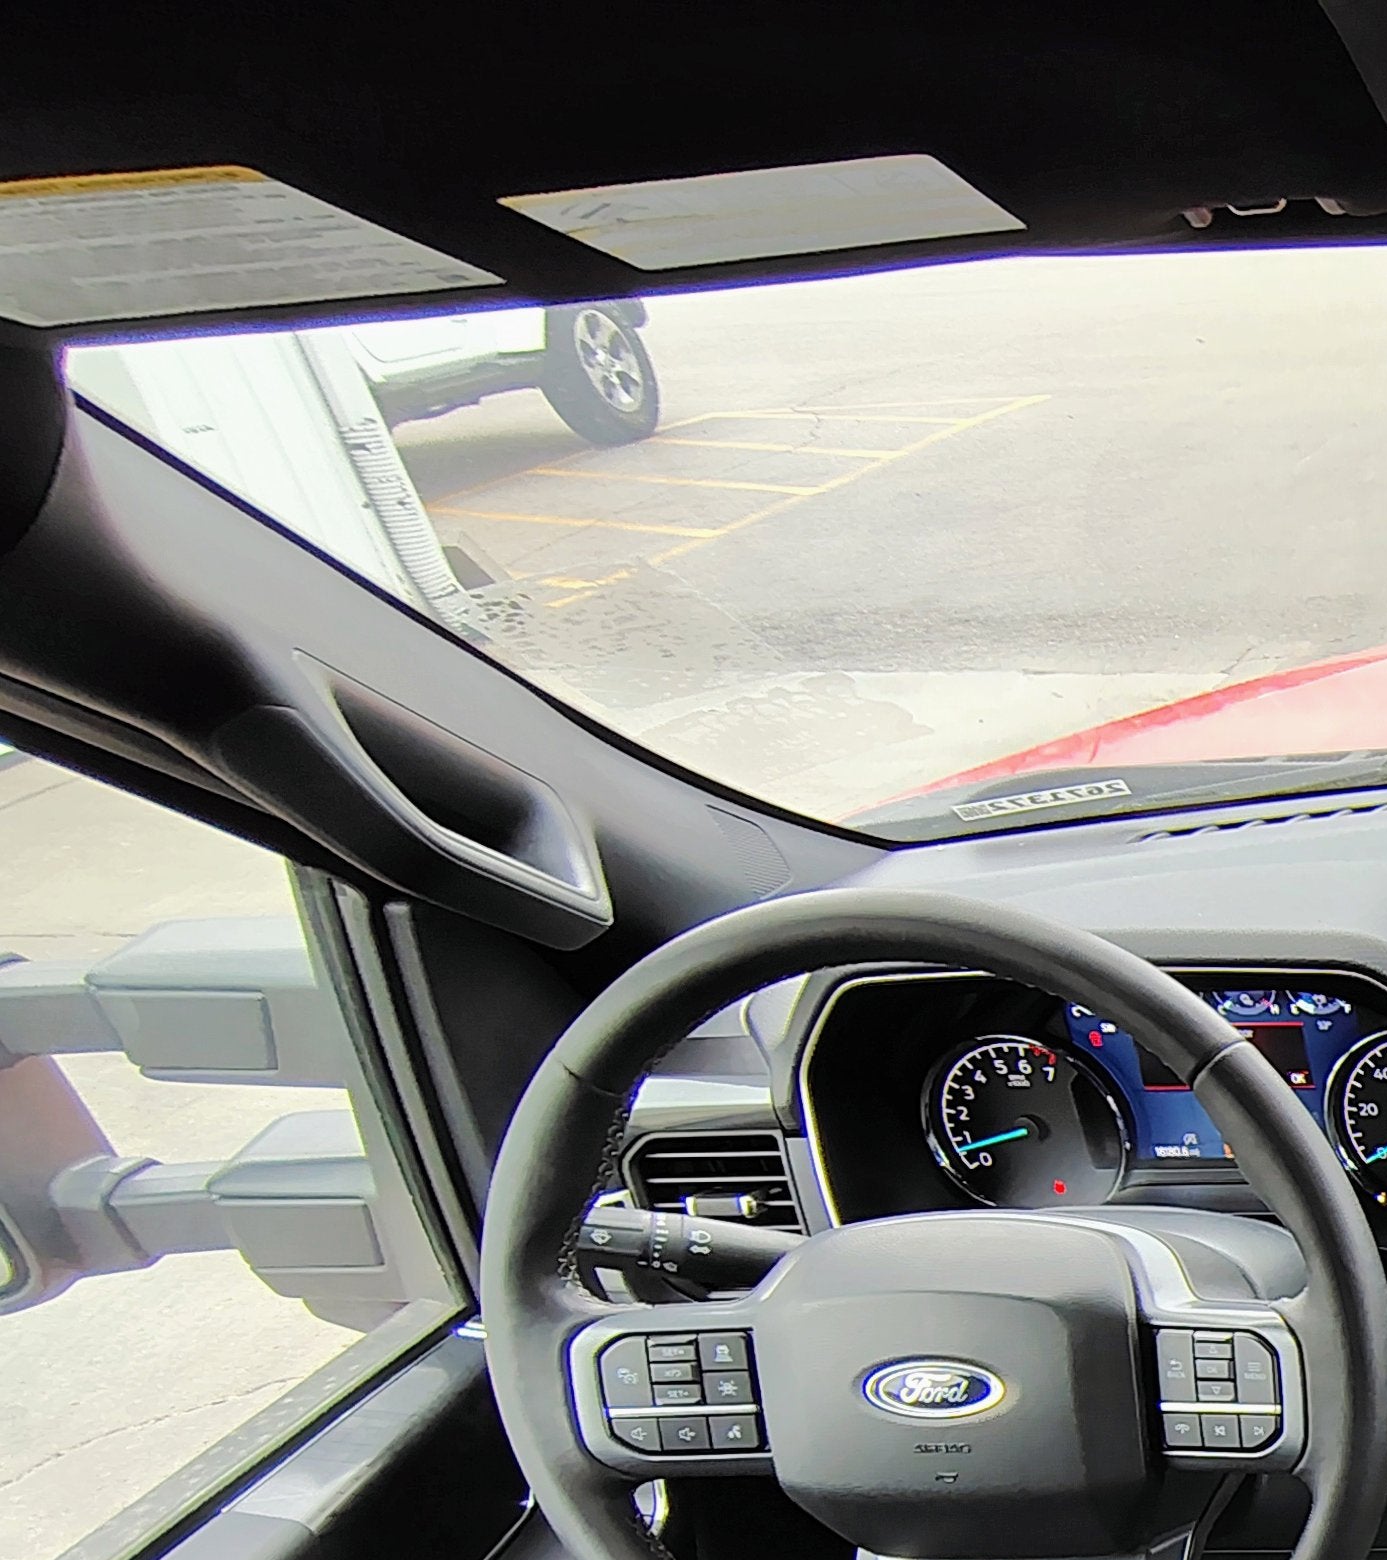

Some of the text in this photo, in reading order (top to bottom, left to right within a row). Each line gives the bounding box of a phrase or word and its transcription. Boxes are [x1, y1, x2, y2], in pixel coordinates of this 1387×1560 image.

[994, 1060, 1008, 1074] 5
[1018, 1060, 1032, 1074] 6
[1042, 1066, 1055, 1082] 7
[974, 1070, 987, 1084] 4
[962, 1085, 975, 1100] 3
[957, 1106, 970, 1120] 2
[1358, 1103, 1378, 1116] 20
[963, 1130, 972, 1143] 1
[979, 1152, 992, 1166] 0
[900, 1372, 969, 1404] Ford
